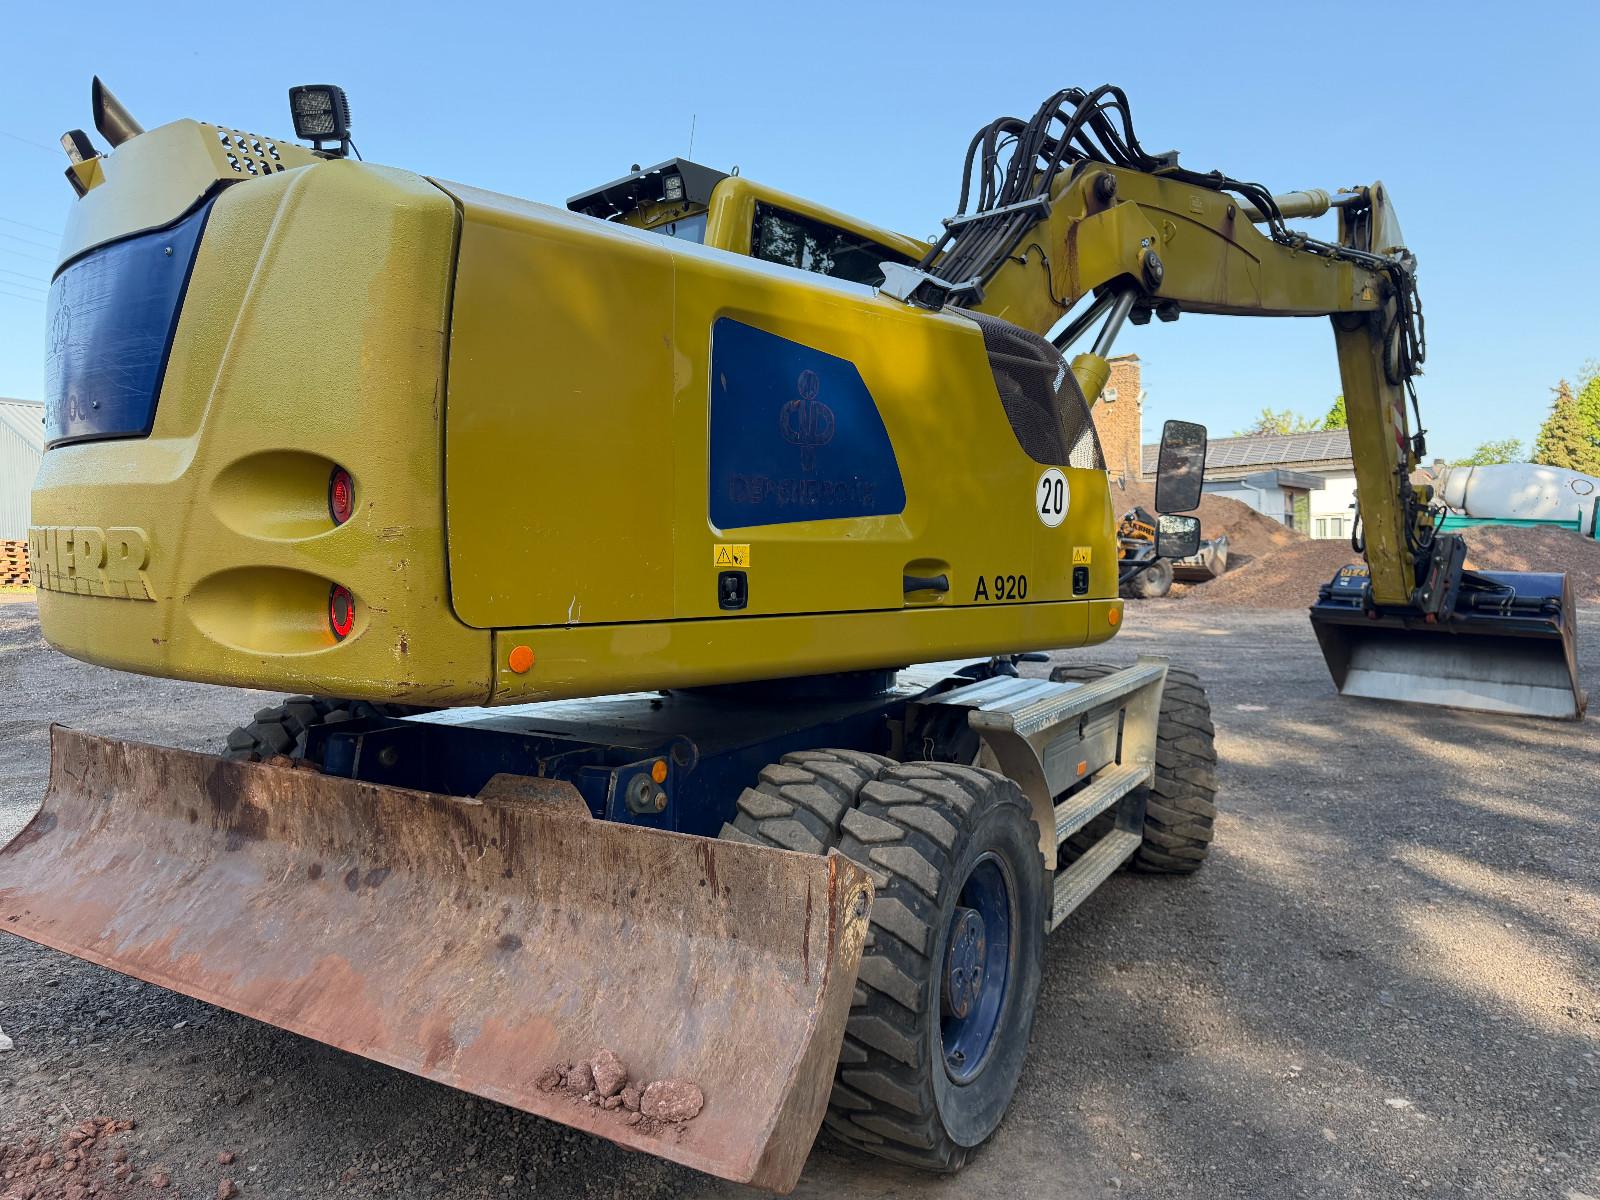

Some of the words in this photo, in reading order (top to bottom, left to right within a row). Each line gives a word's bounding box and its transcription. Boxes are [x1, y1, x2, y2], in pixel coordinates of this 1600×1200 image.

[1042, 478, 1063, 515] 20
[974, 576, 989, 601] A
[994, 575, 1027, 600] 920
